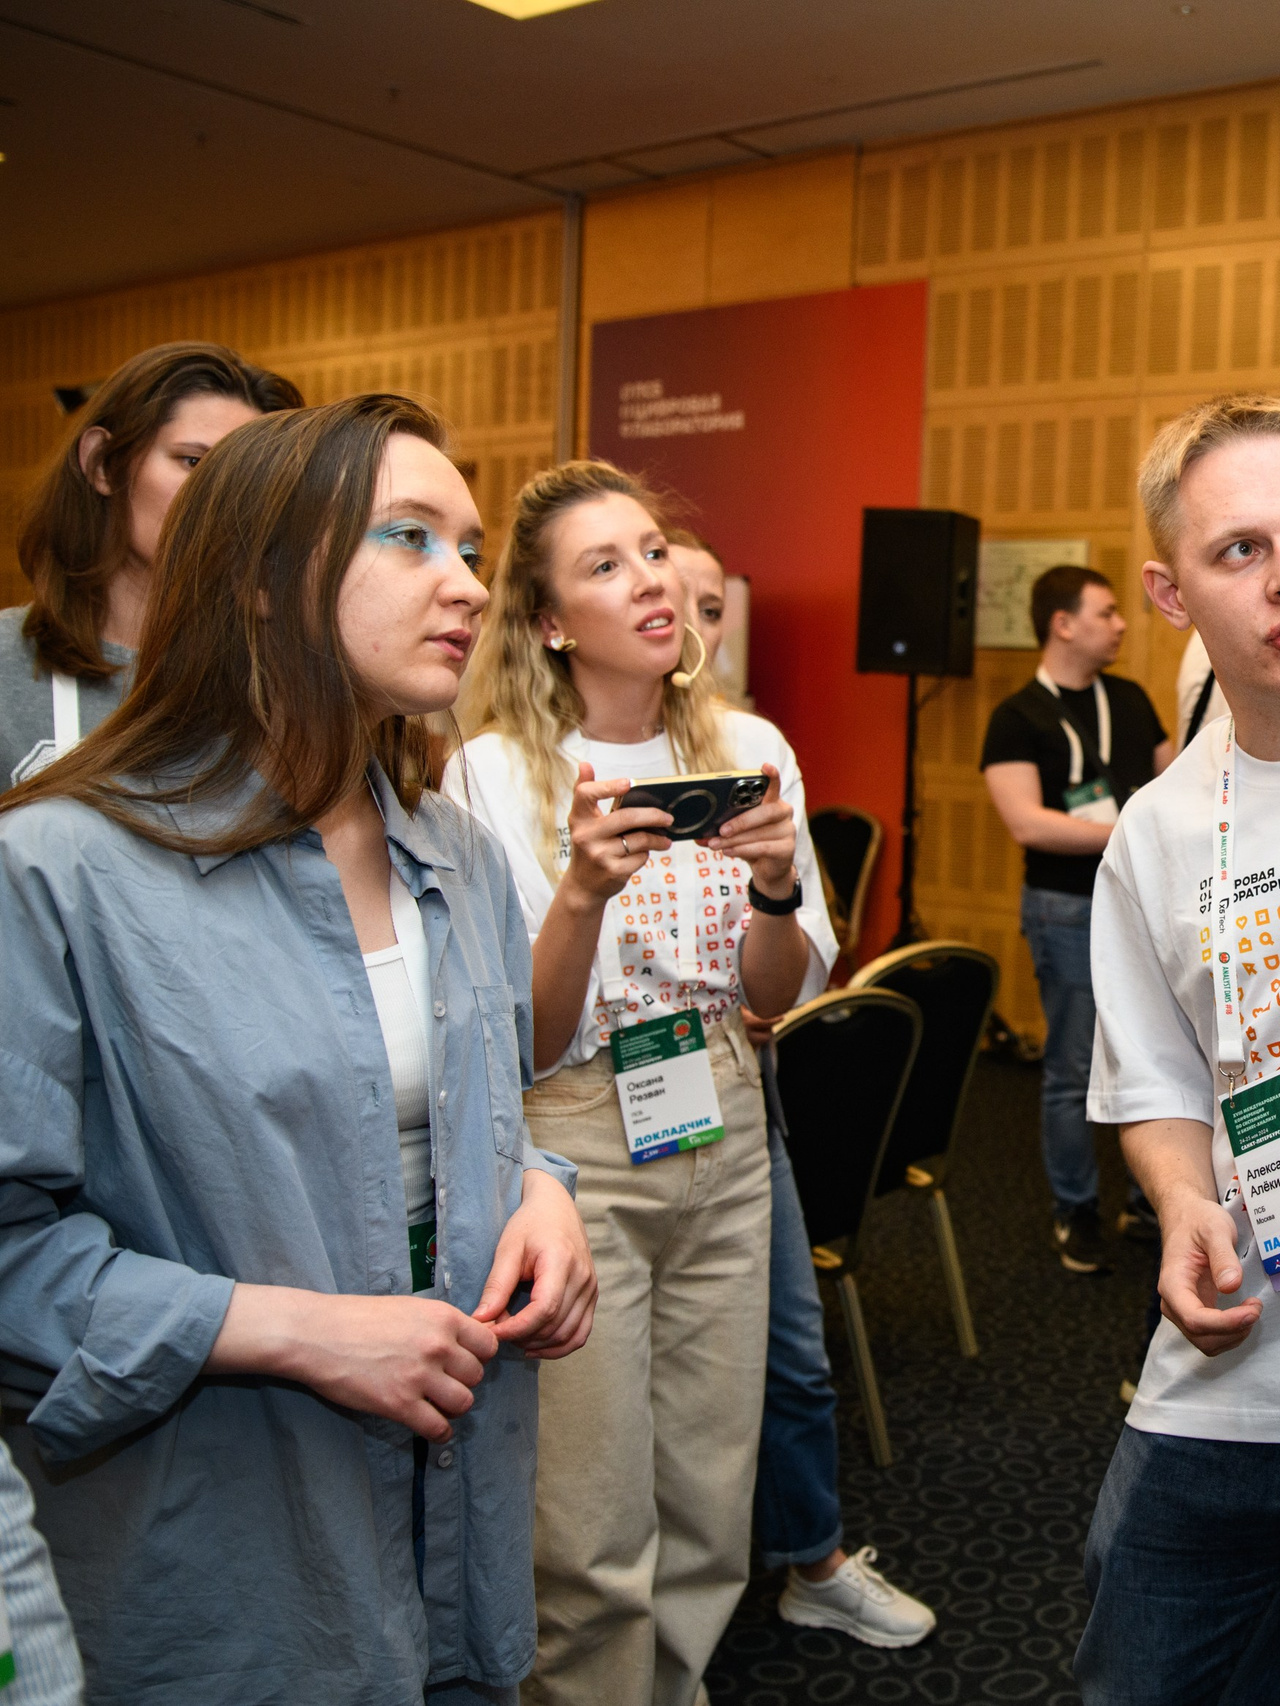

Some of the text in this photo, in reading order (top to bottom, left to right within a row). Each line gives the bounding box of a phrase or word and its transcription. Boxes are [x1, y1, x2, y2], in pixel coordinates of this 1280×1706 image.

[1218, 916, 1226, 934] Tech
[1222, 966, 1230, 988] ANALYST
[1224, 989, 1232, 1002] DAYS
[627, 1076, 664, 1092] Оксана
[629, 1088, 666, 1104] Резван
[634, 1116, 712, 1148] ДОКЛАДЧИК
[1241, 1130, 1280, 1150] САНКТ-ПЕТЕРБУРГ
[1258, 1128, 1268, 1136] 2024
[1254, 1206, 1266, 1216] ПСБ
[1256, 1214, 1276, 1225] Москва
